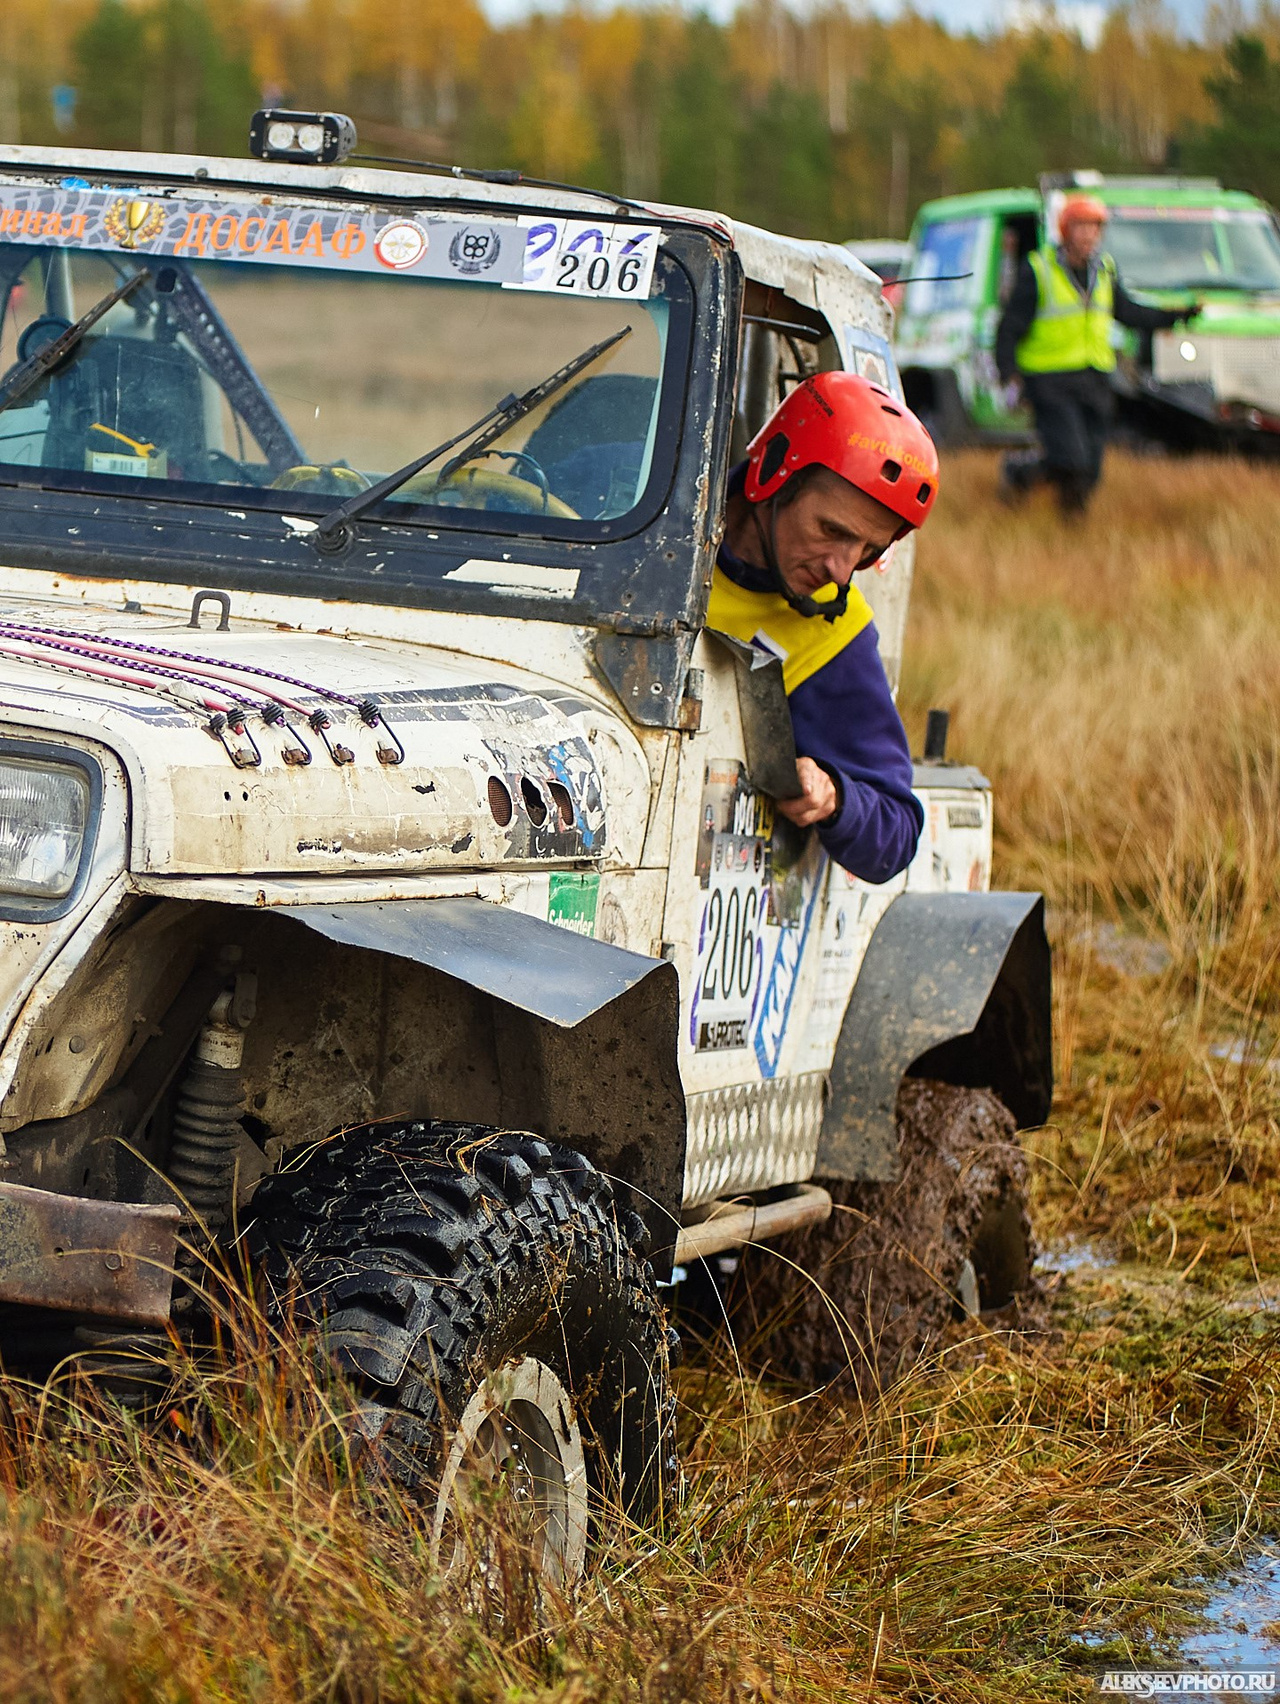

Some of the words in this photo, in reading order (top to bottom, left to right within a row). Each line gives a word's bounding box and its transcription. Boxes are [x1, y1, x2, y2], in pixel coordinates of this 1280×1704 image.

[174, 212, 367, 260] ДОСААФ
[556, 254, 641, 293] 206
[702, 886, 757, 1000] 206
